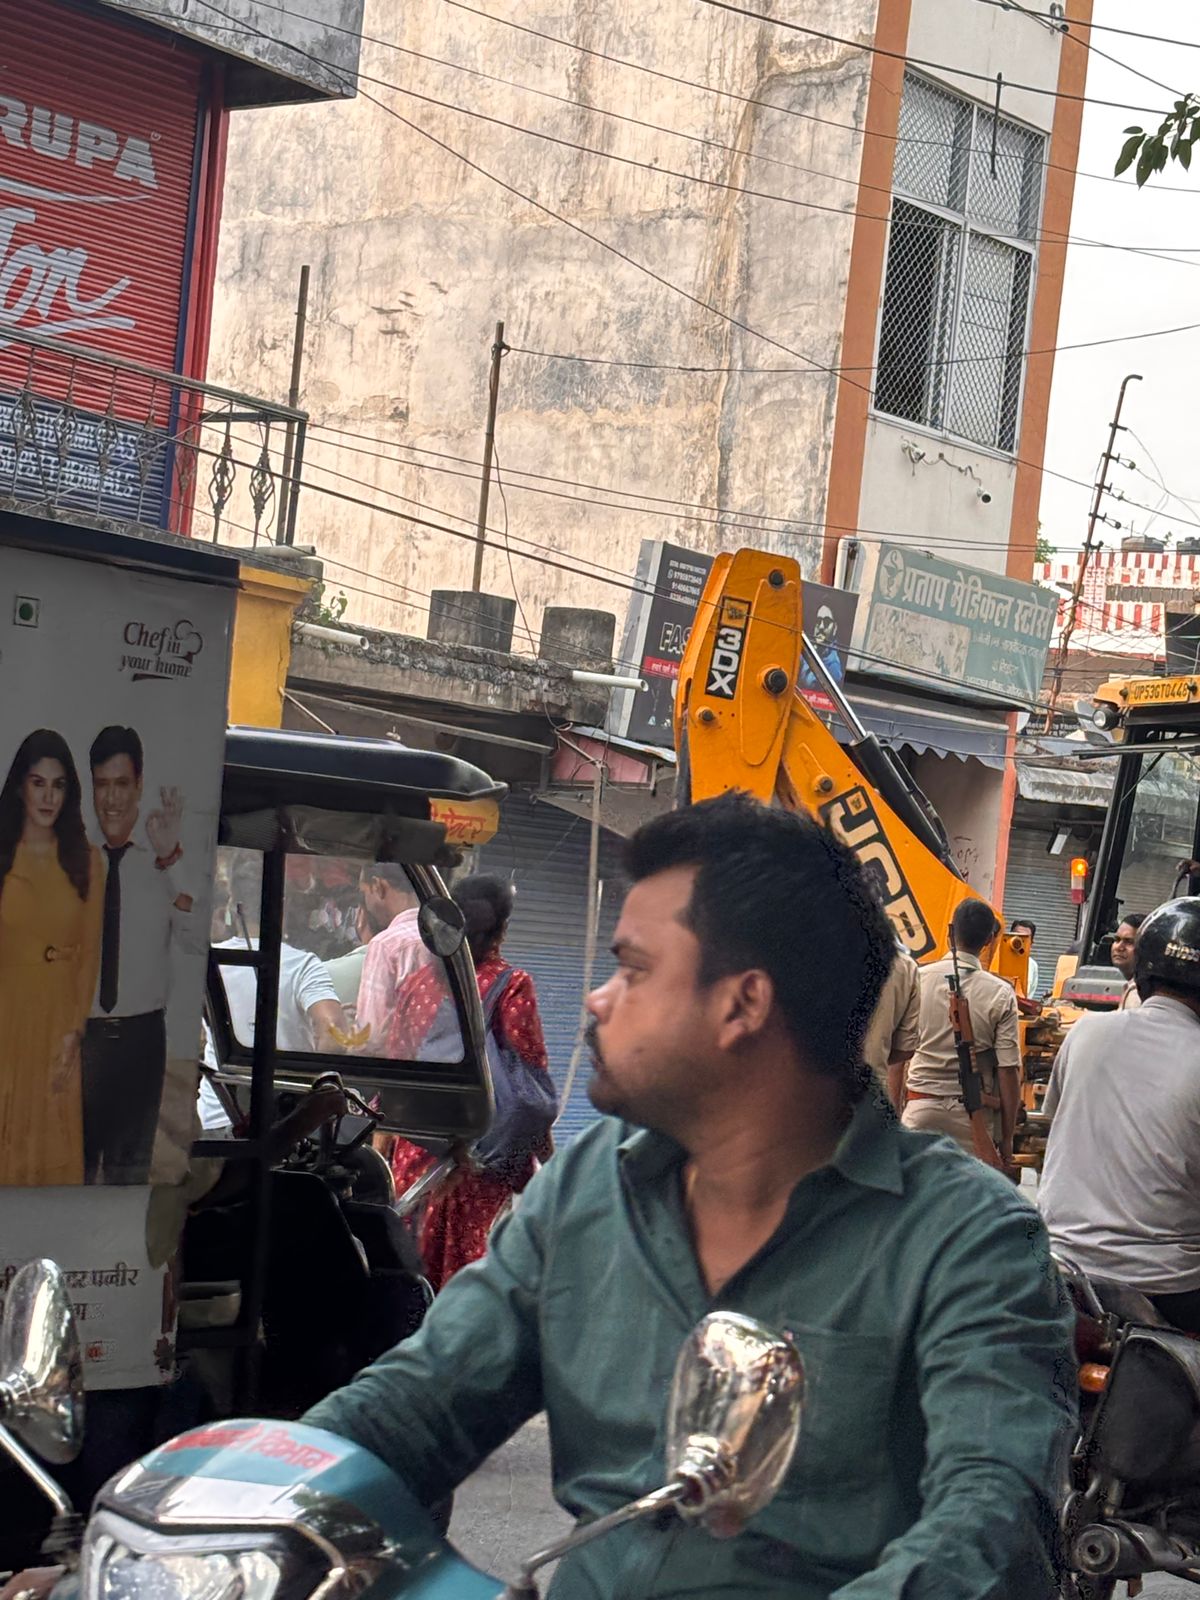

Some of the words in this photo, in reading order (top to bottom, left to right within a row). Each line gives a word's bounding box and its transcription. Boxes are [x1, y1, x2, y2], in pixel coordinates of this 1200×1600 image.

[903, 567, 950, 611] प्रताप
[951, 571, 1015, 628] मेडिकल
[124, 622, 170, 656] Chef
[707, 626, 742, 696] 3DX
